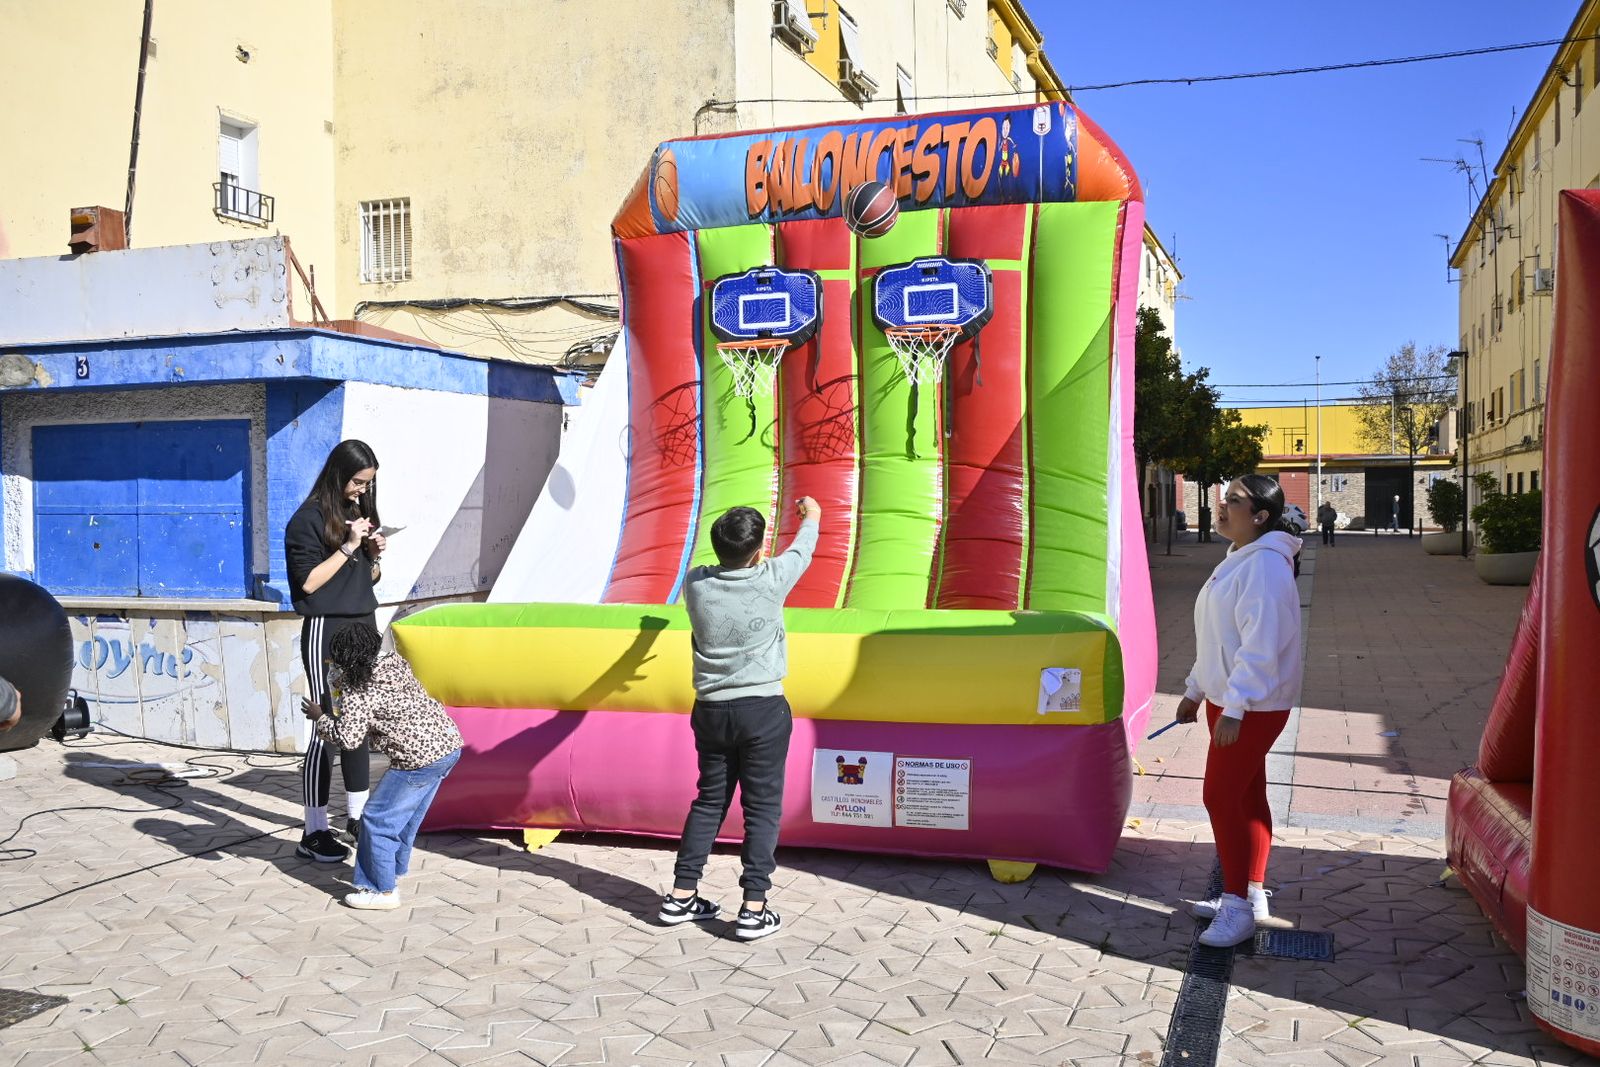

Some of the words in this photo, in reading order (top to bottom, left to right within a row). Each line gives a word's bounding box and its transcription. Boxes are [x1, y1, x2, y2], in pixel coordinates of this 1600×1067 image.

[77, 356, 88, 377] 3
[905, 761, 934, 769] NORMAS
[835, 804, 866, 813] AYLLON
